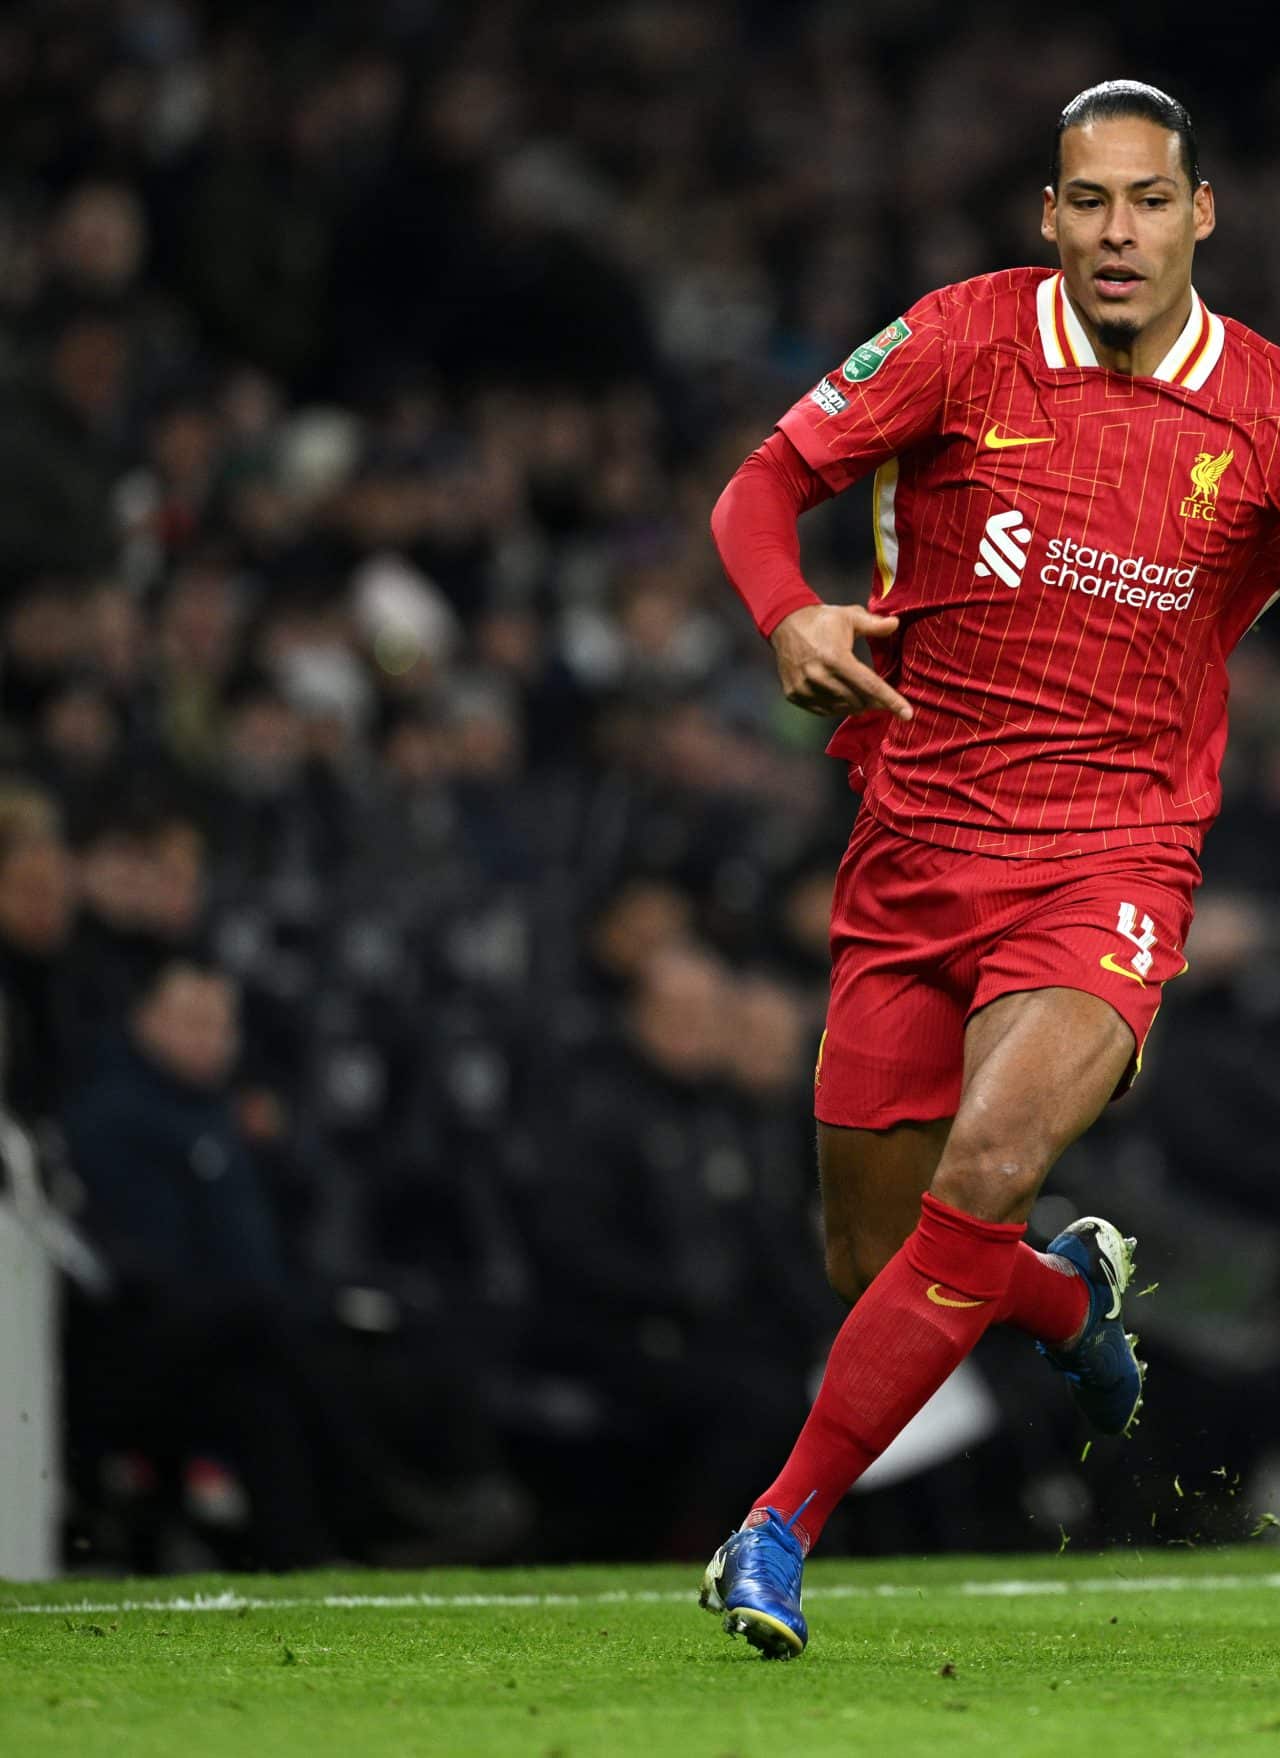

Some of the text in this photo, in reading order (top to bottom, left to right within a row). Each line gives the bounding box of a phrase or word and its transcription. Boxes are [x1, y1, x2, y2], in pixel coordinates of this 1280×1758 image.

[1039, 563, 1195, 612] chartered
[1045, 537, 1198, 588] standard
[1116, 901, 1158, 978] 4
